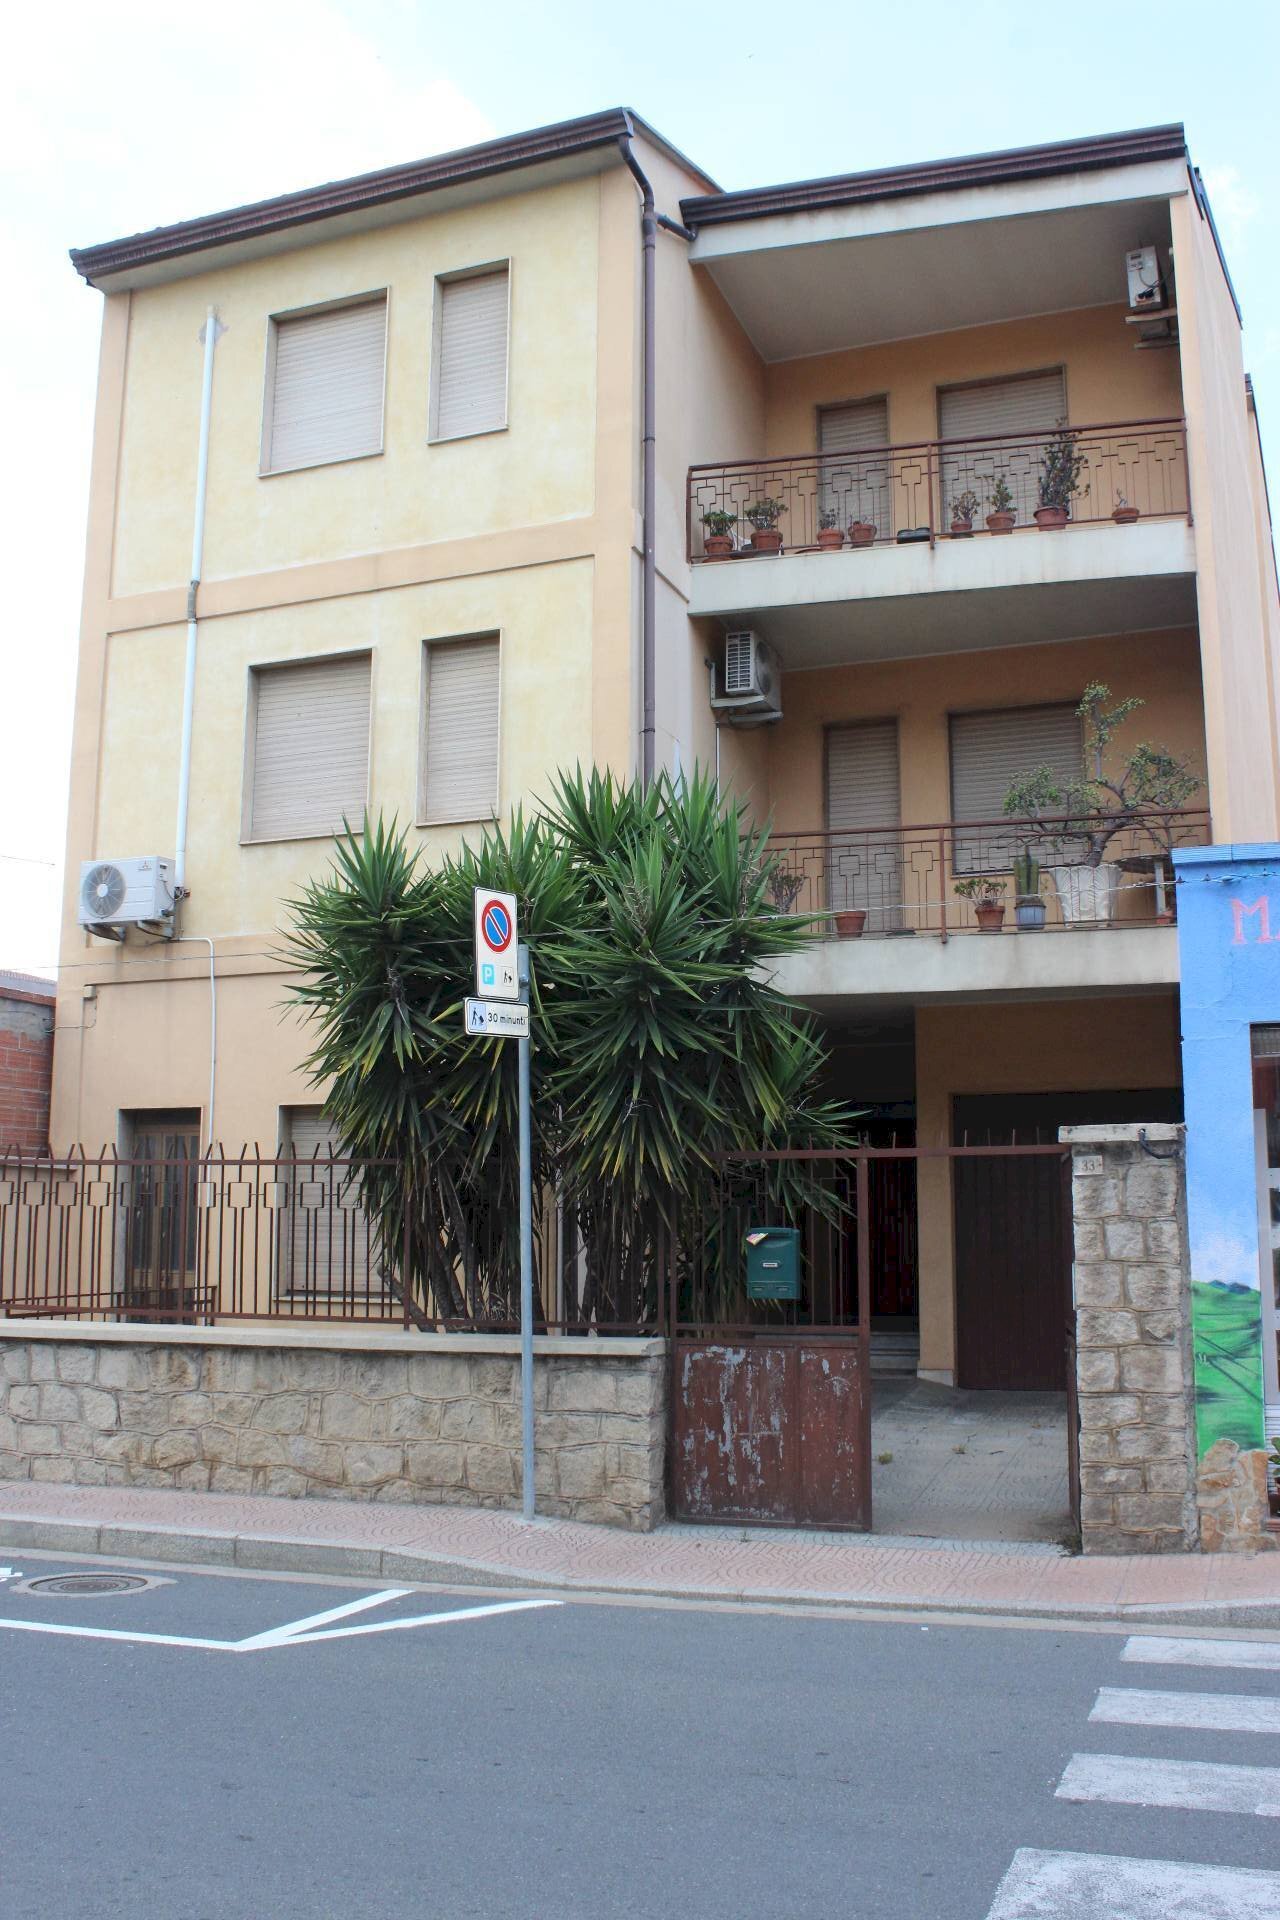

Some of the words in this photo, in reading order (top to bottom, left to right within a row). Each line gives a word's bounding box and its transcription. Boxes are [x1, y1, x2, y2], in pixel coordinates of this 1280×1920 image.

[1231, 896, 1280, 944] M
[483, 965, 493, 983] P
[487, 1012, 498, 1022] 30
